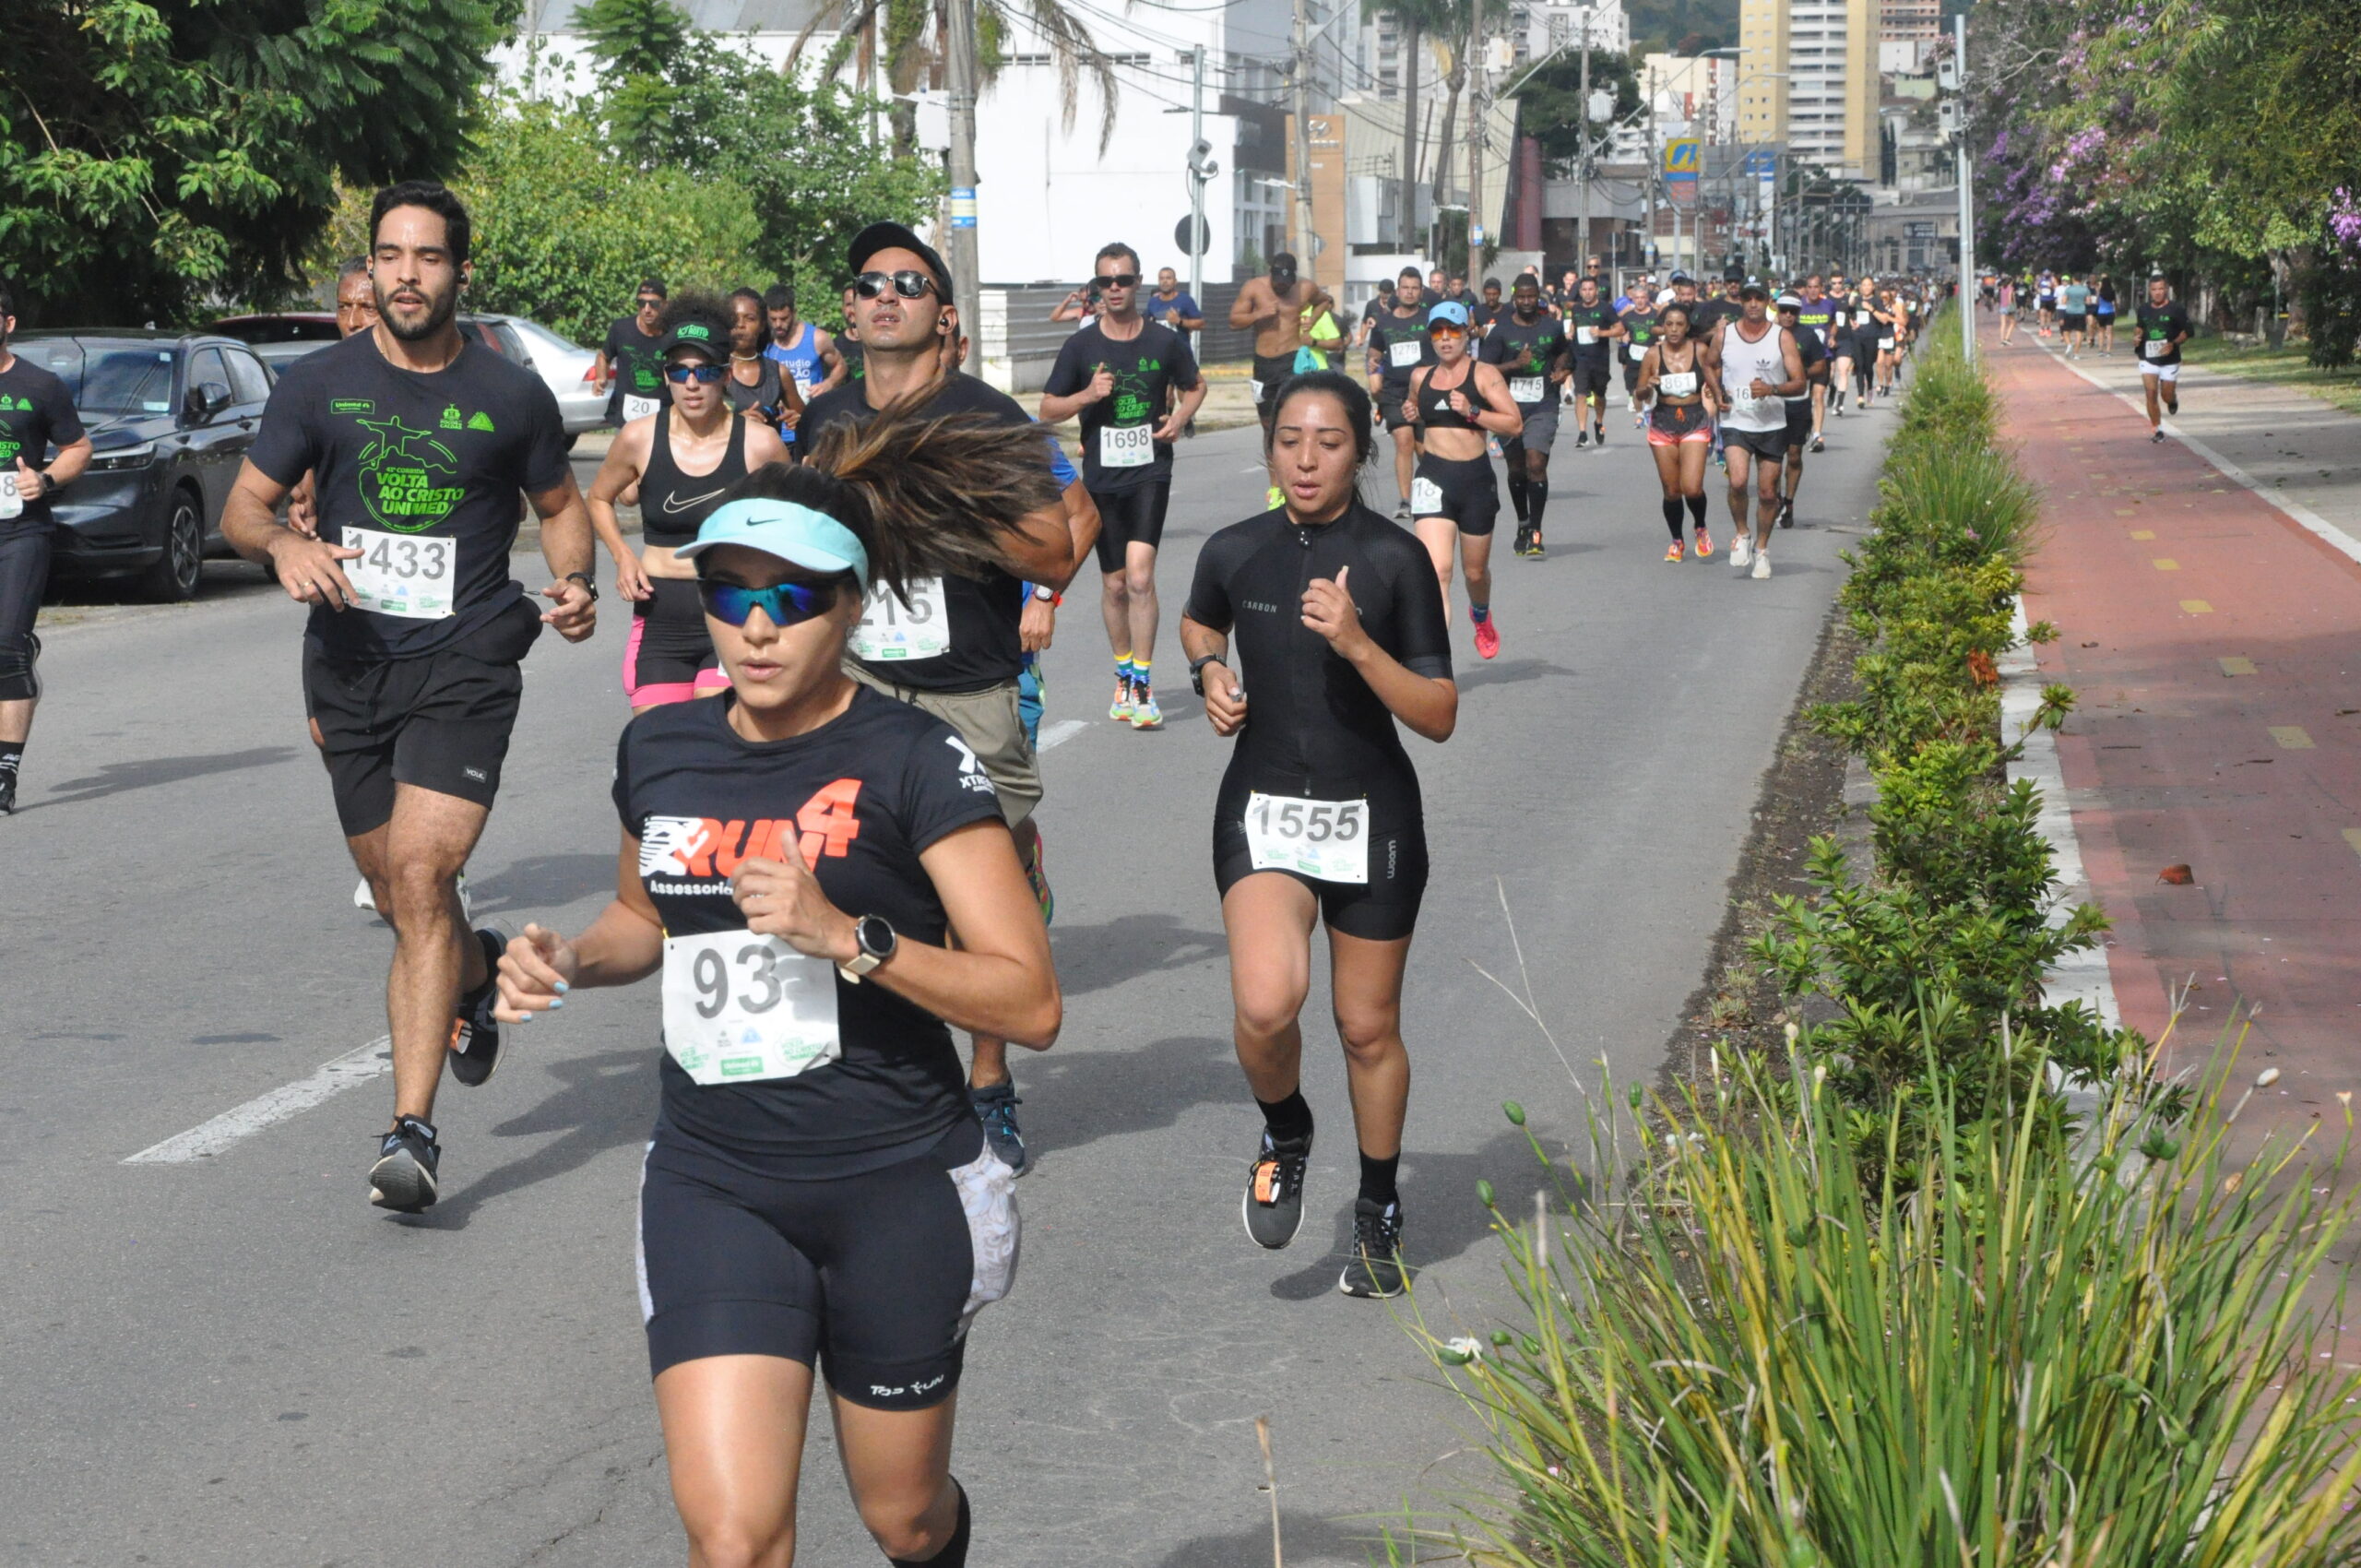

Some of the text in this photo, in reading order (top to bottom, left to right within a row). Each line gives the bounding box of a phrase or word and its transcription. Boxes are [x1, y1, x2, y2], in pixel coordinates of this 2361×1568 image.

[1513, 379, 1542, 391] 1715
[1735, 387, 1750, 399] 16
[632, 399, 650, 413] 20
[1104, 428, 1149, 449] 1698
[0, 476, 16, 496] 8
[376, 472, 428, 488] VOLTA
[378, 487, 465, 502] AO CRISTO
[1413, 481, 1437, 497] 18
[382, 500, 449, 516] UNIMED
[349, 533, 445, 580] 1433
[1242, 600, 1277, 612] CARBON
[1252, 800, 1359, 841] 1555
[650, 880, 734, 895] Assessoria
[693, 943, 783, 1019] 93
